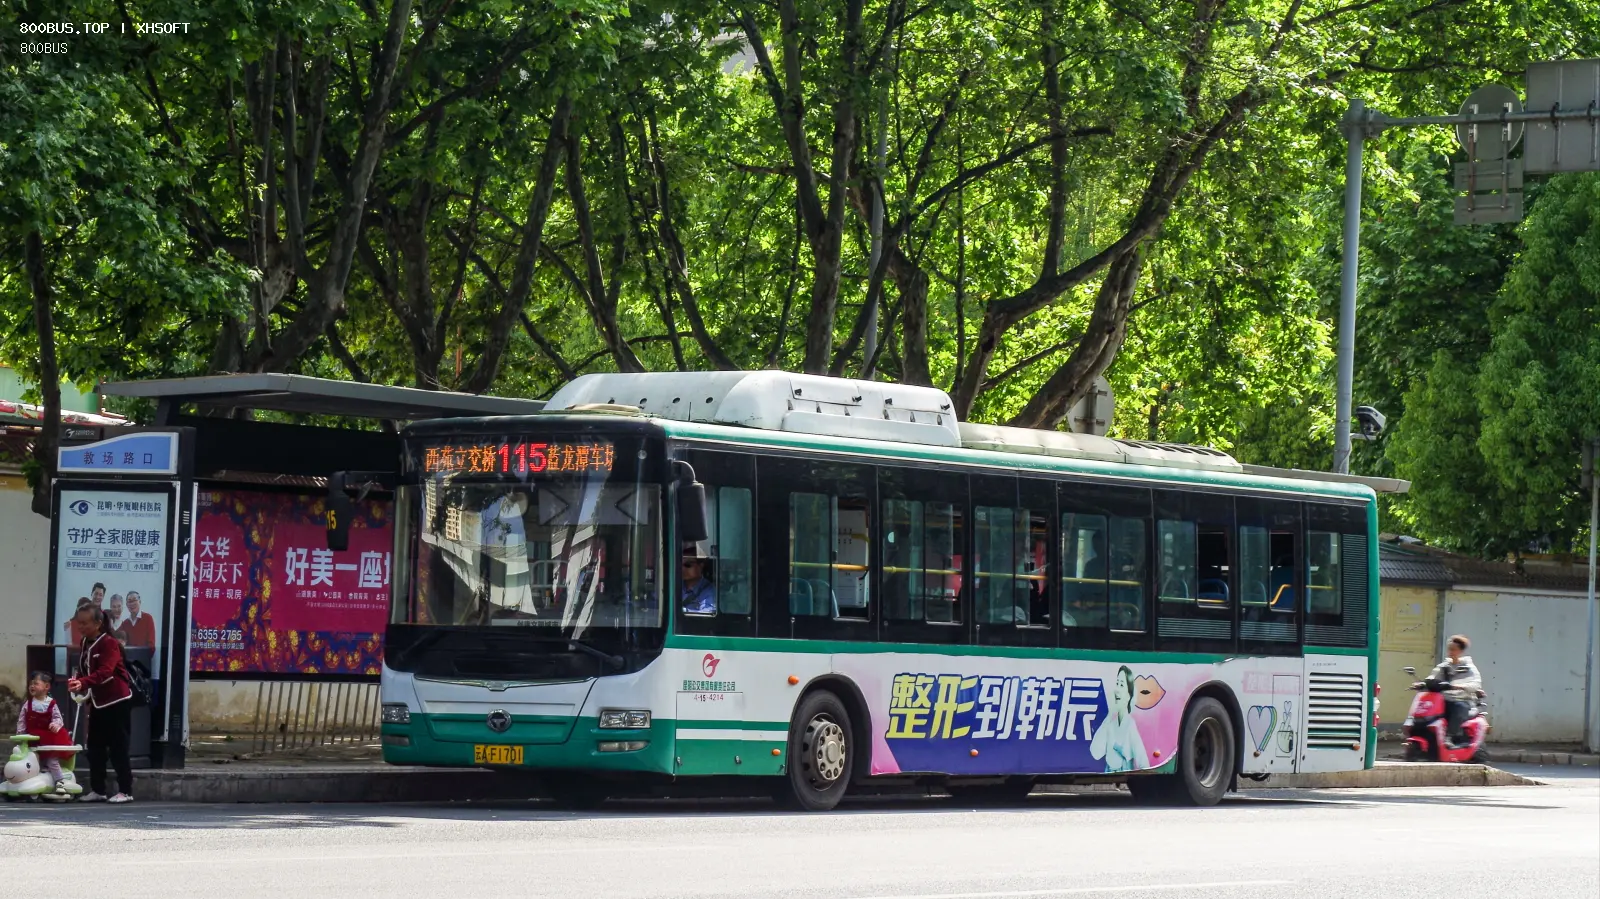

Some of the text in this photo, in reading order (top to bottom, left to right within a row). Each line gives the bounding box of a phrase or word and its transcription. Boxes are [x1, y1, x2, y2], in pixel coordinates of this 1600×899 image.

[83, 451, 153, 465] 教场路口
[498, 443, 548, 473] 115
[325, 509, 337, 530] 15
[67, 527, 161, 547] 守护全家眼健康
[200, 535, 231, 560] 大华
[197, 629, 218, 640] 6355
[885, 672, 1103, 741] 整形到韩辰
